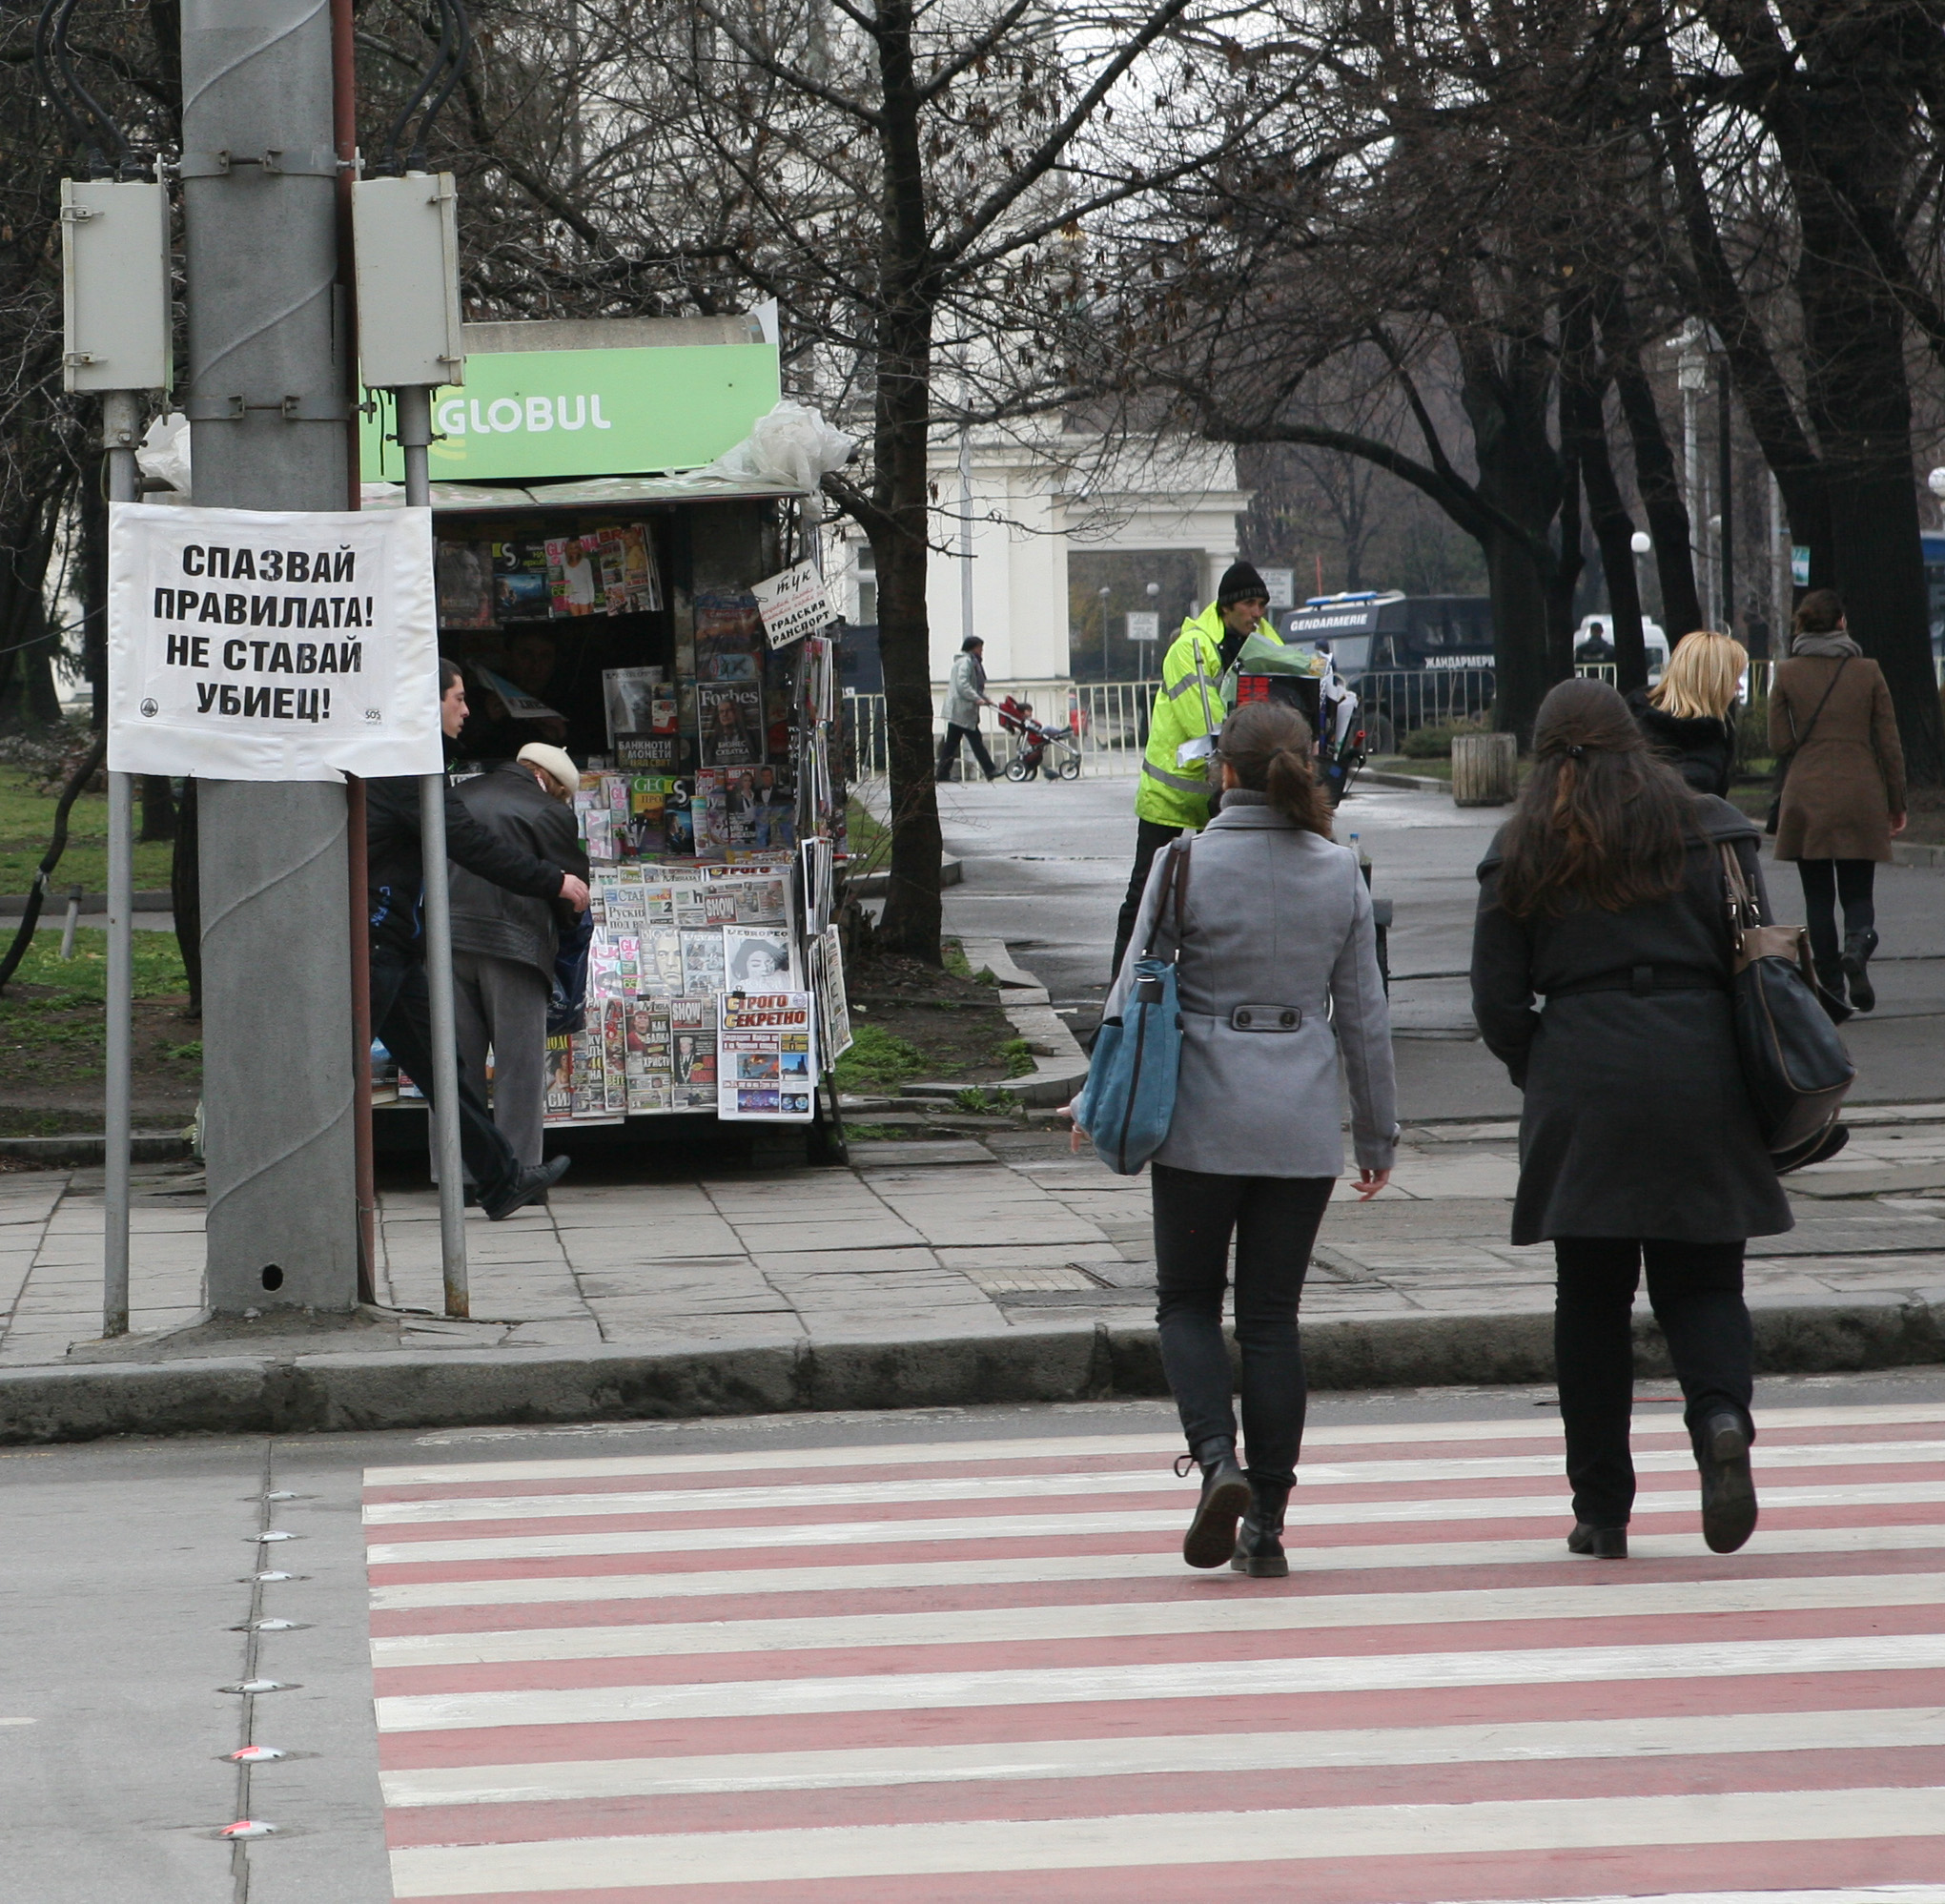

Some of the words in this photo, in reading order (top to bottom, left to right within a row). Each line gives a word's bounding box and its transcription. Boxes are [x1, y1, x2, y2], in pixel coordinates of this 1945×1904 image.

[438, 394, 612, 434] GLOBUL
[182, 544, 356, 583] СПАЗВАЙ
[154, 587, 374, 628] ПРАВИЛАТА!
[770, 600, 827, 632] ГРАДСКИЯ
[1290, 613, 1368, 631] GENDARMERIE
[166, 634, 211, 668] НЕ
[223, 635, 362, 673] СТАВАЙ
[195, 683, 331, 723] УБИЕЦ!
[701, 689, 759, 706] Forbes
[618, 741, 672, 751] БАНКНОТИ
[627, 749, 672, 760] МОНЕТИ
[706, 899, 734, 918] SHOW
[727, 929, 788, 938] L'EUROPEO
[672, 1002, 701, 1021] SHOW
[725, 1011, 807, 1029] СЕКРЕТНО
